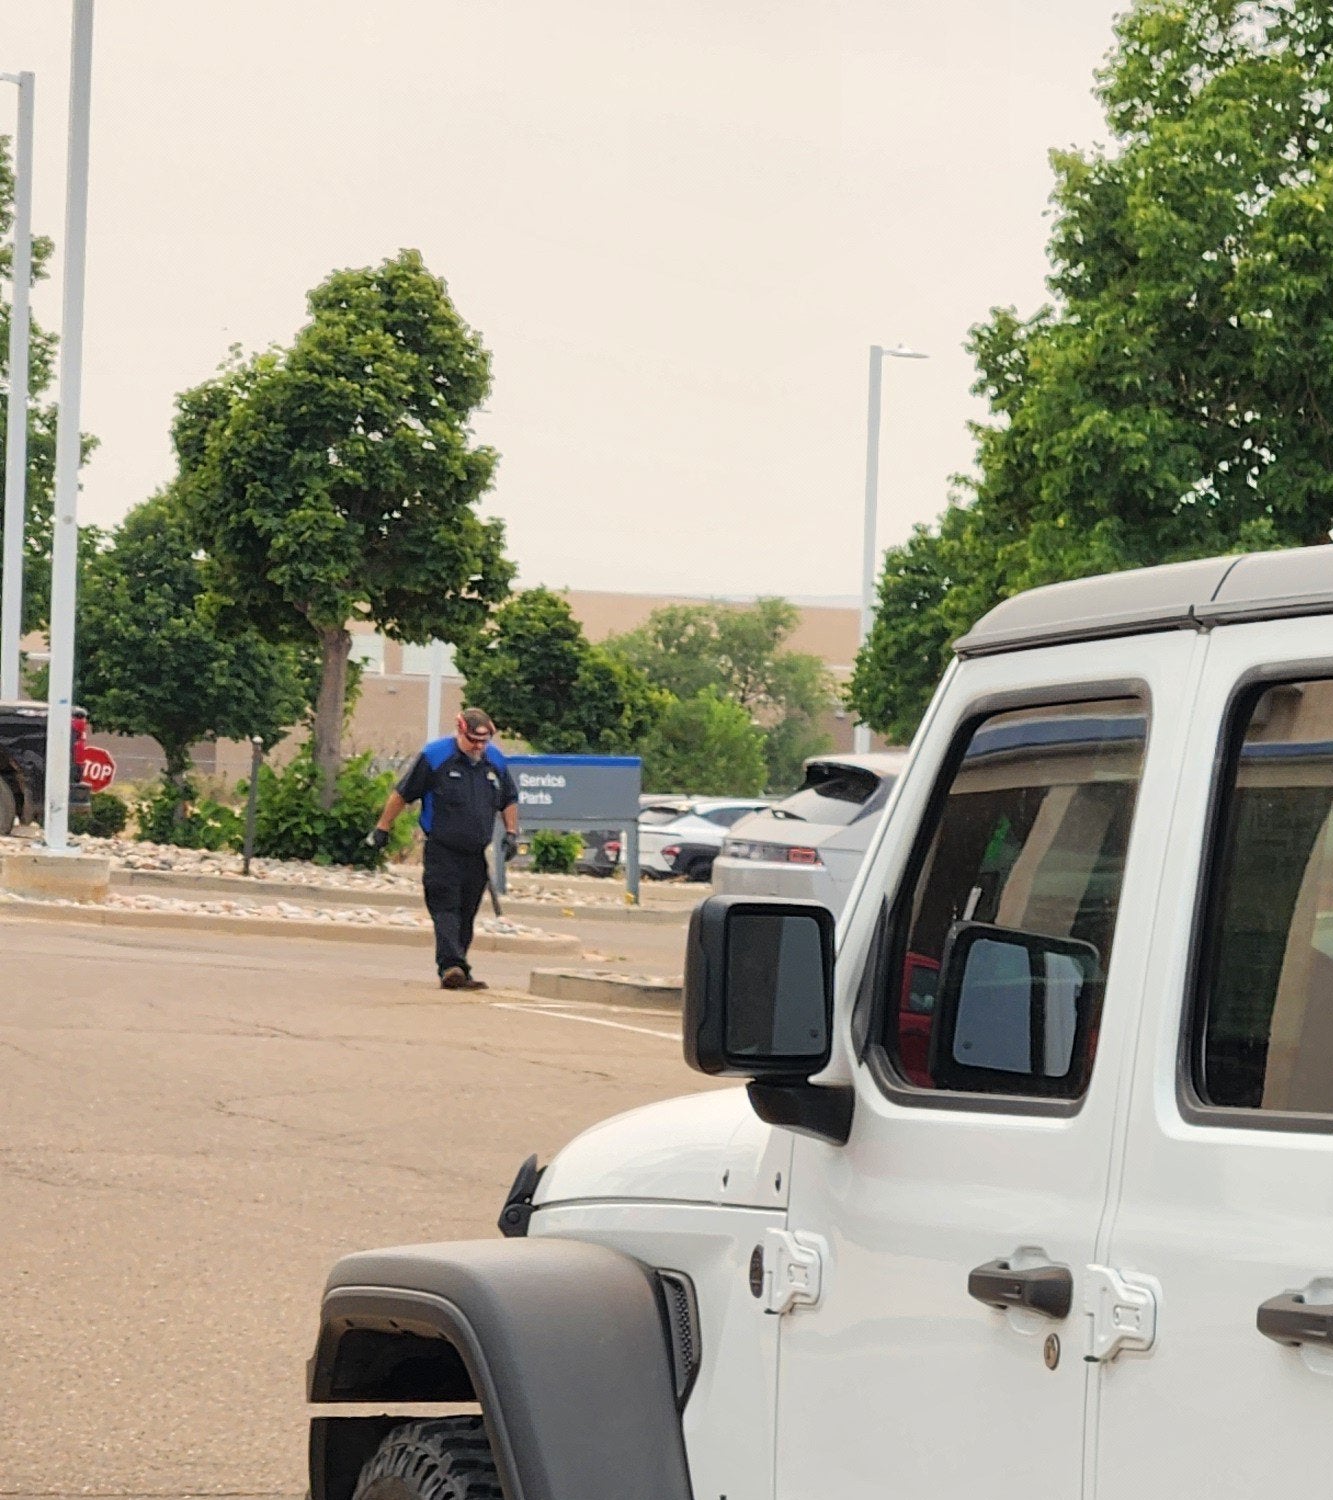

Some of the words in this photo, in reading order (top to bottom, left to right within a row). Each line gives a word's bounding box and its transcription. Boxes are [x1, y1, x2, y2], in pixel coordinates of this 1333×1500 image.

[83, 759, 113, 781] TOP
[519, 772, 567, 788] Service
[518, 790, 553, 805] Parts
